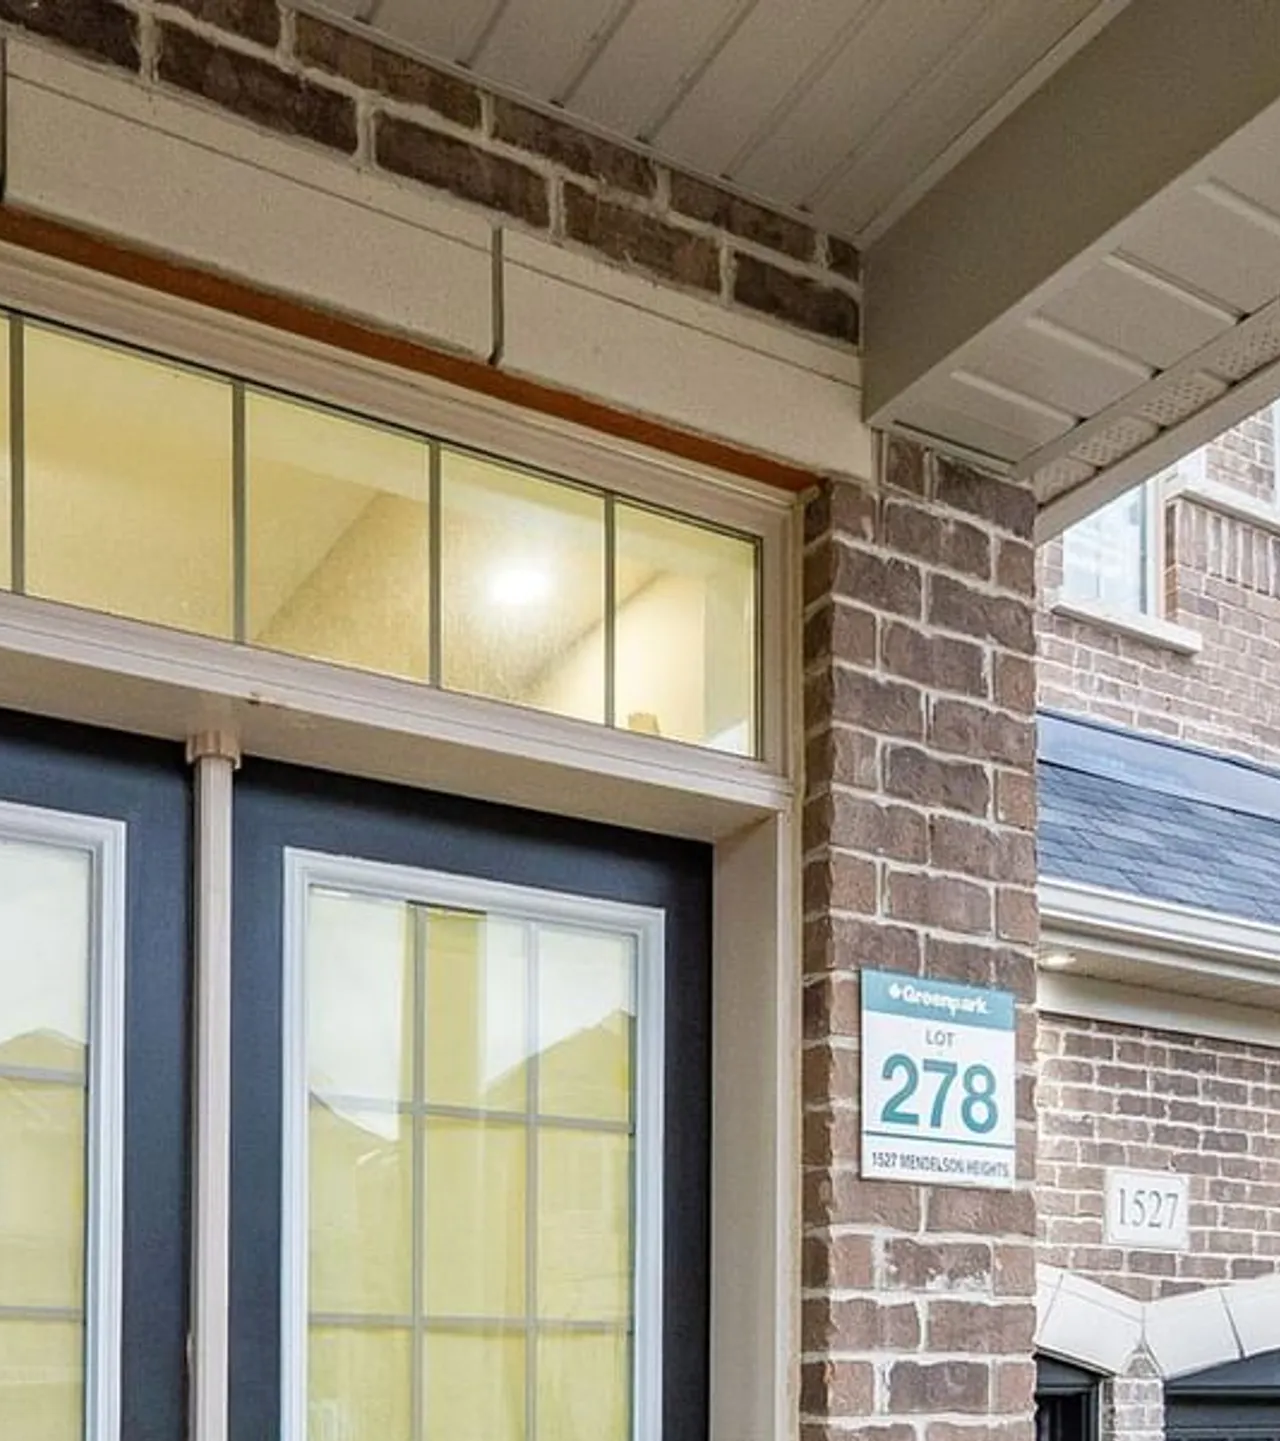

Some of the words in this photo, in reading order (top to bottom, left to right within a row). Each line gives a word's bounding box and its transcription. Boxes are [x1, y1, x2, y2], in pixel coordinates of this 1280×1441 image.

[926, 1029, 955, 1047] LOT
[880, 1053, 999, 1134] 278
[872, 1151, 897, 1169] 1527
[899, 1153, 964, 1174] MENDELSON
[966, 1160, 1010, 1178] HEIGHTS
[1119, 1188, 1179, 1230] 1527
